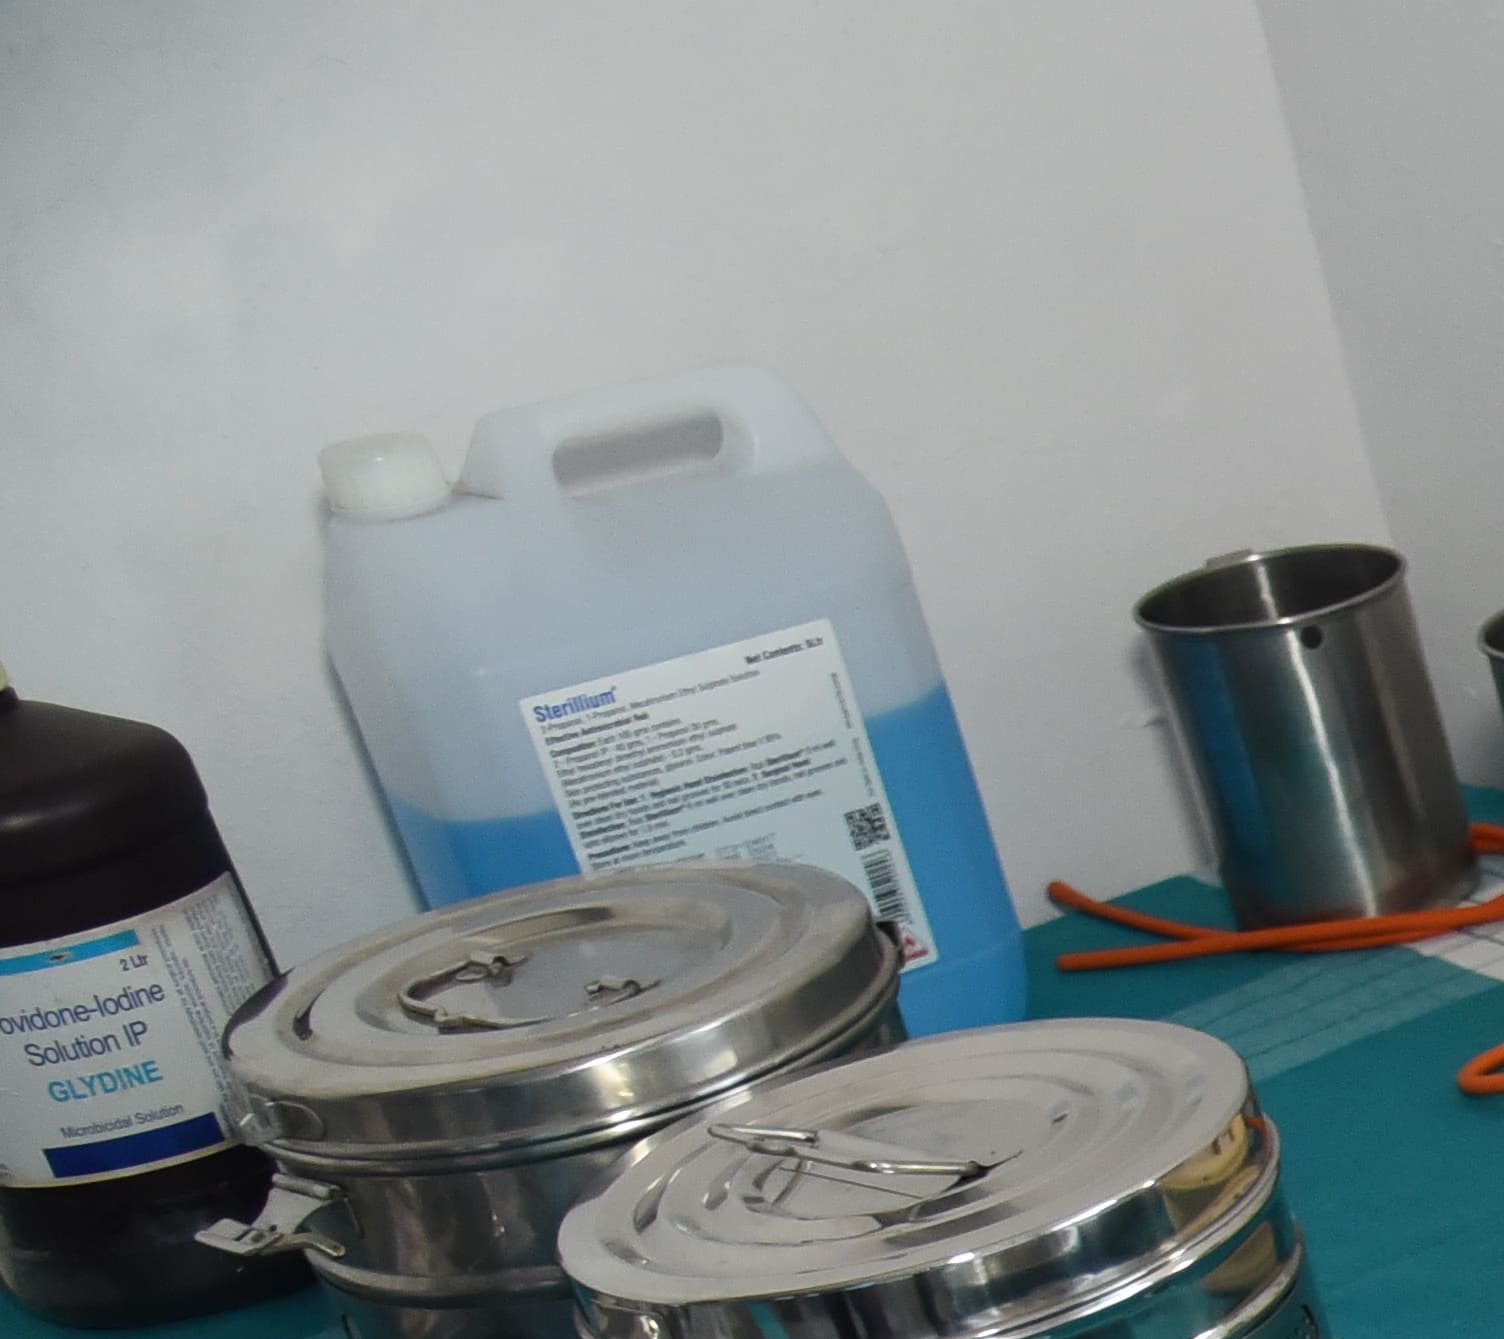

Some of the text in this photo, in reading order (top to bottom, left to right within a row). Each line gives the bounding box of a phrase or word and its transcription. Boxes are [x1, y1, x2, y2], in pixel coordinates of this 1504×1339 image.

[533, 688, 615, 722] Sterillium
[119, 958, 130, 972] 2
[0, 983, 166, 1036] ovidone-Iodine
[24, 1020, 149, 1067] Solution IP
[47, 1060, 163, 1103] GLYDINE
[60, 1103, 184, 1139] Microbicidal Solution
